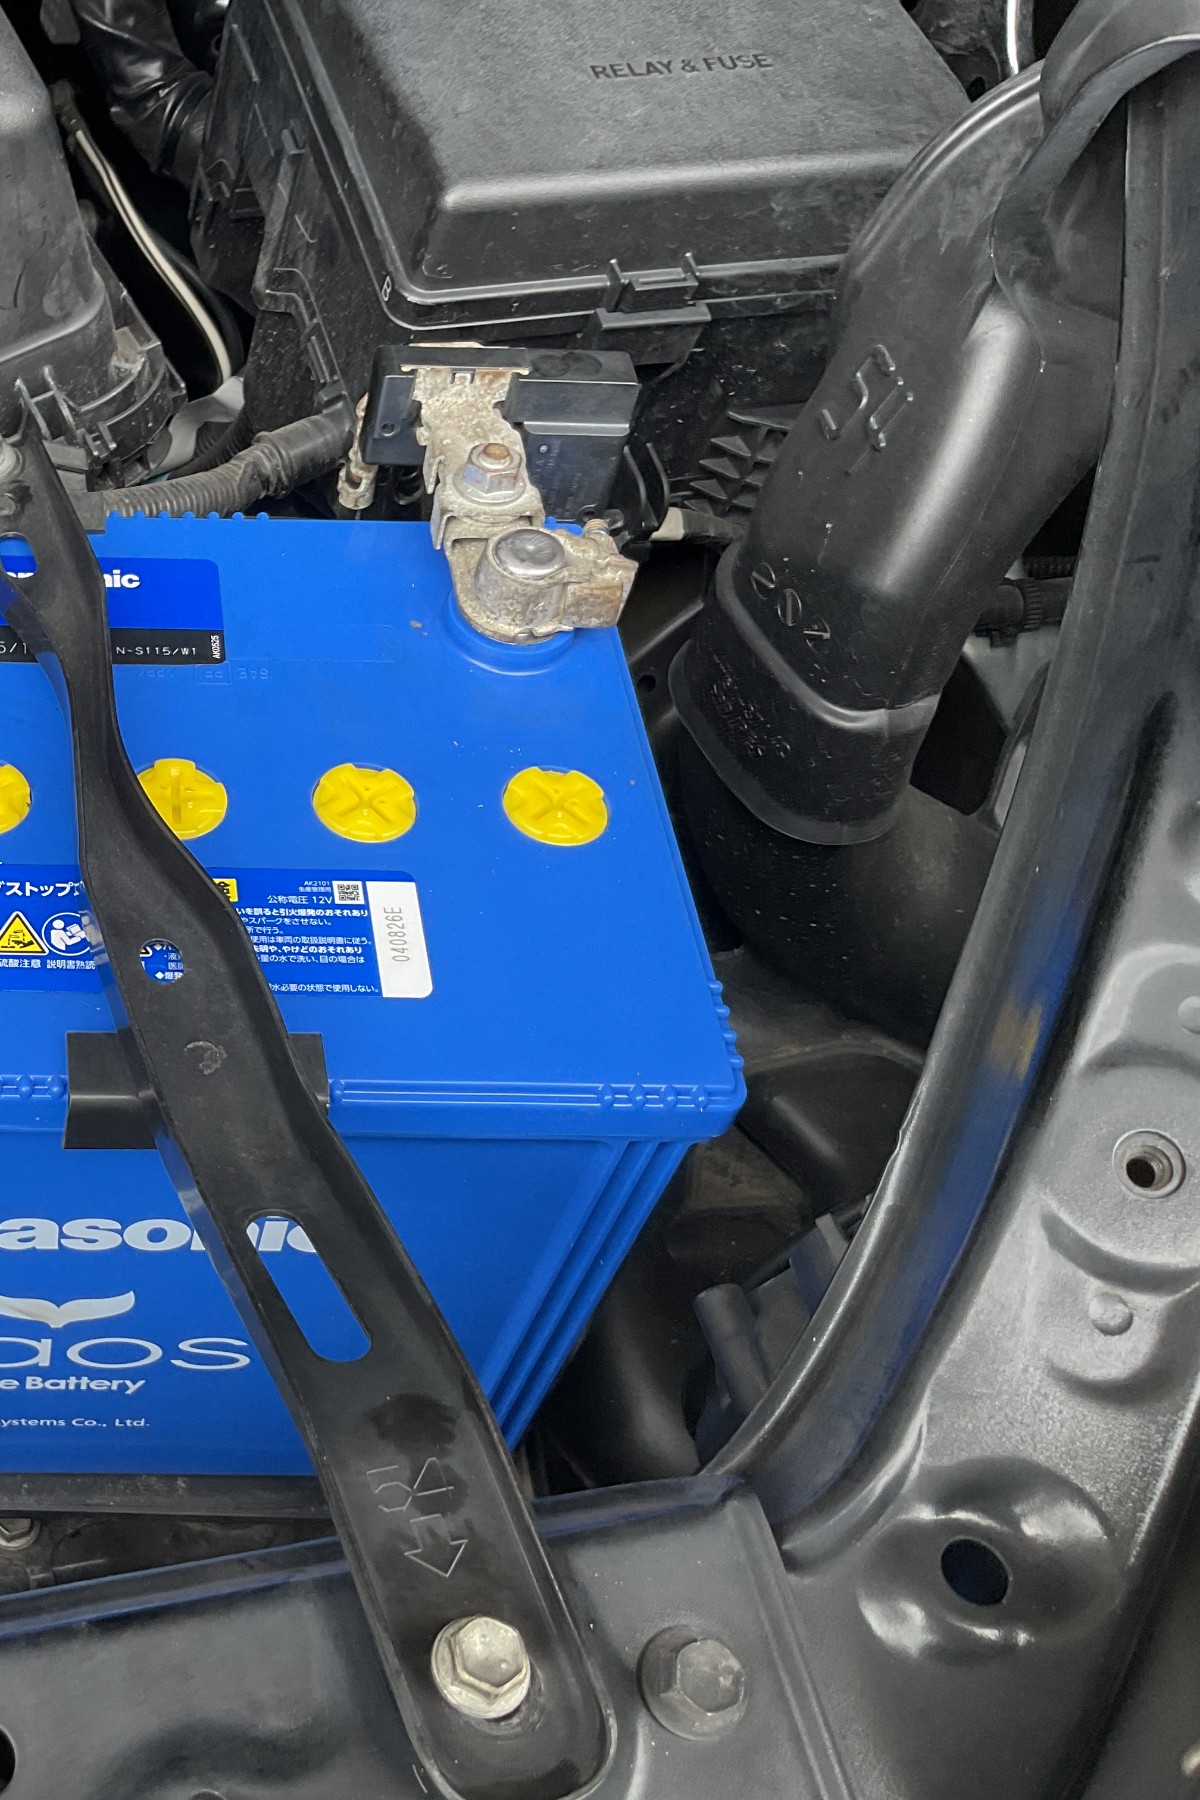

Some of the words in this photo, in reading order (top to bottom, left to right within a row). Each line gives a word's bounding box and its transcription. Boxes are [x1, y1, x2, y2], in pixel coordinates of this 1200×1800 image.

[590, 60, 673, 79] RELAY
[681, 59, 699, 73] &
[702, 53, 773, 72] FUSE
[267, 895, 309, 905] 公称電圧
[312, 896, 333, 904] 12V
[383, 906, 410, 962] 040826E
[46, 959, 96, 970] 説明書熟読
[256, 954, 365, 964] 量の水で洗い、目の場合は
[26, 1375, 145, 1395] Battery
[71, 1417, 107, 1429] Co.,
[114, 1418, 151, 1428] Ltd.
